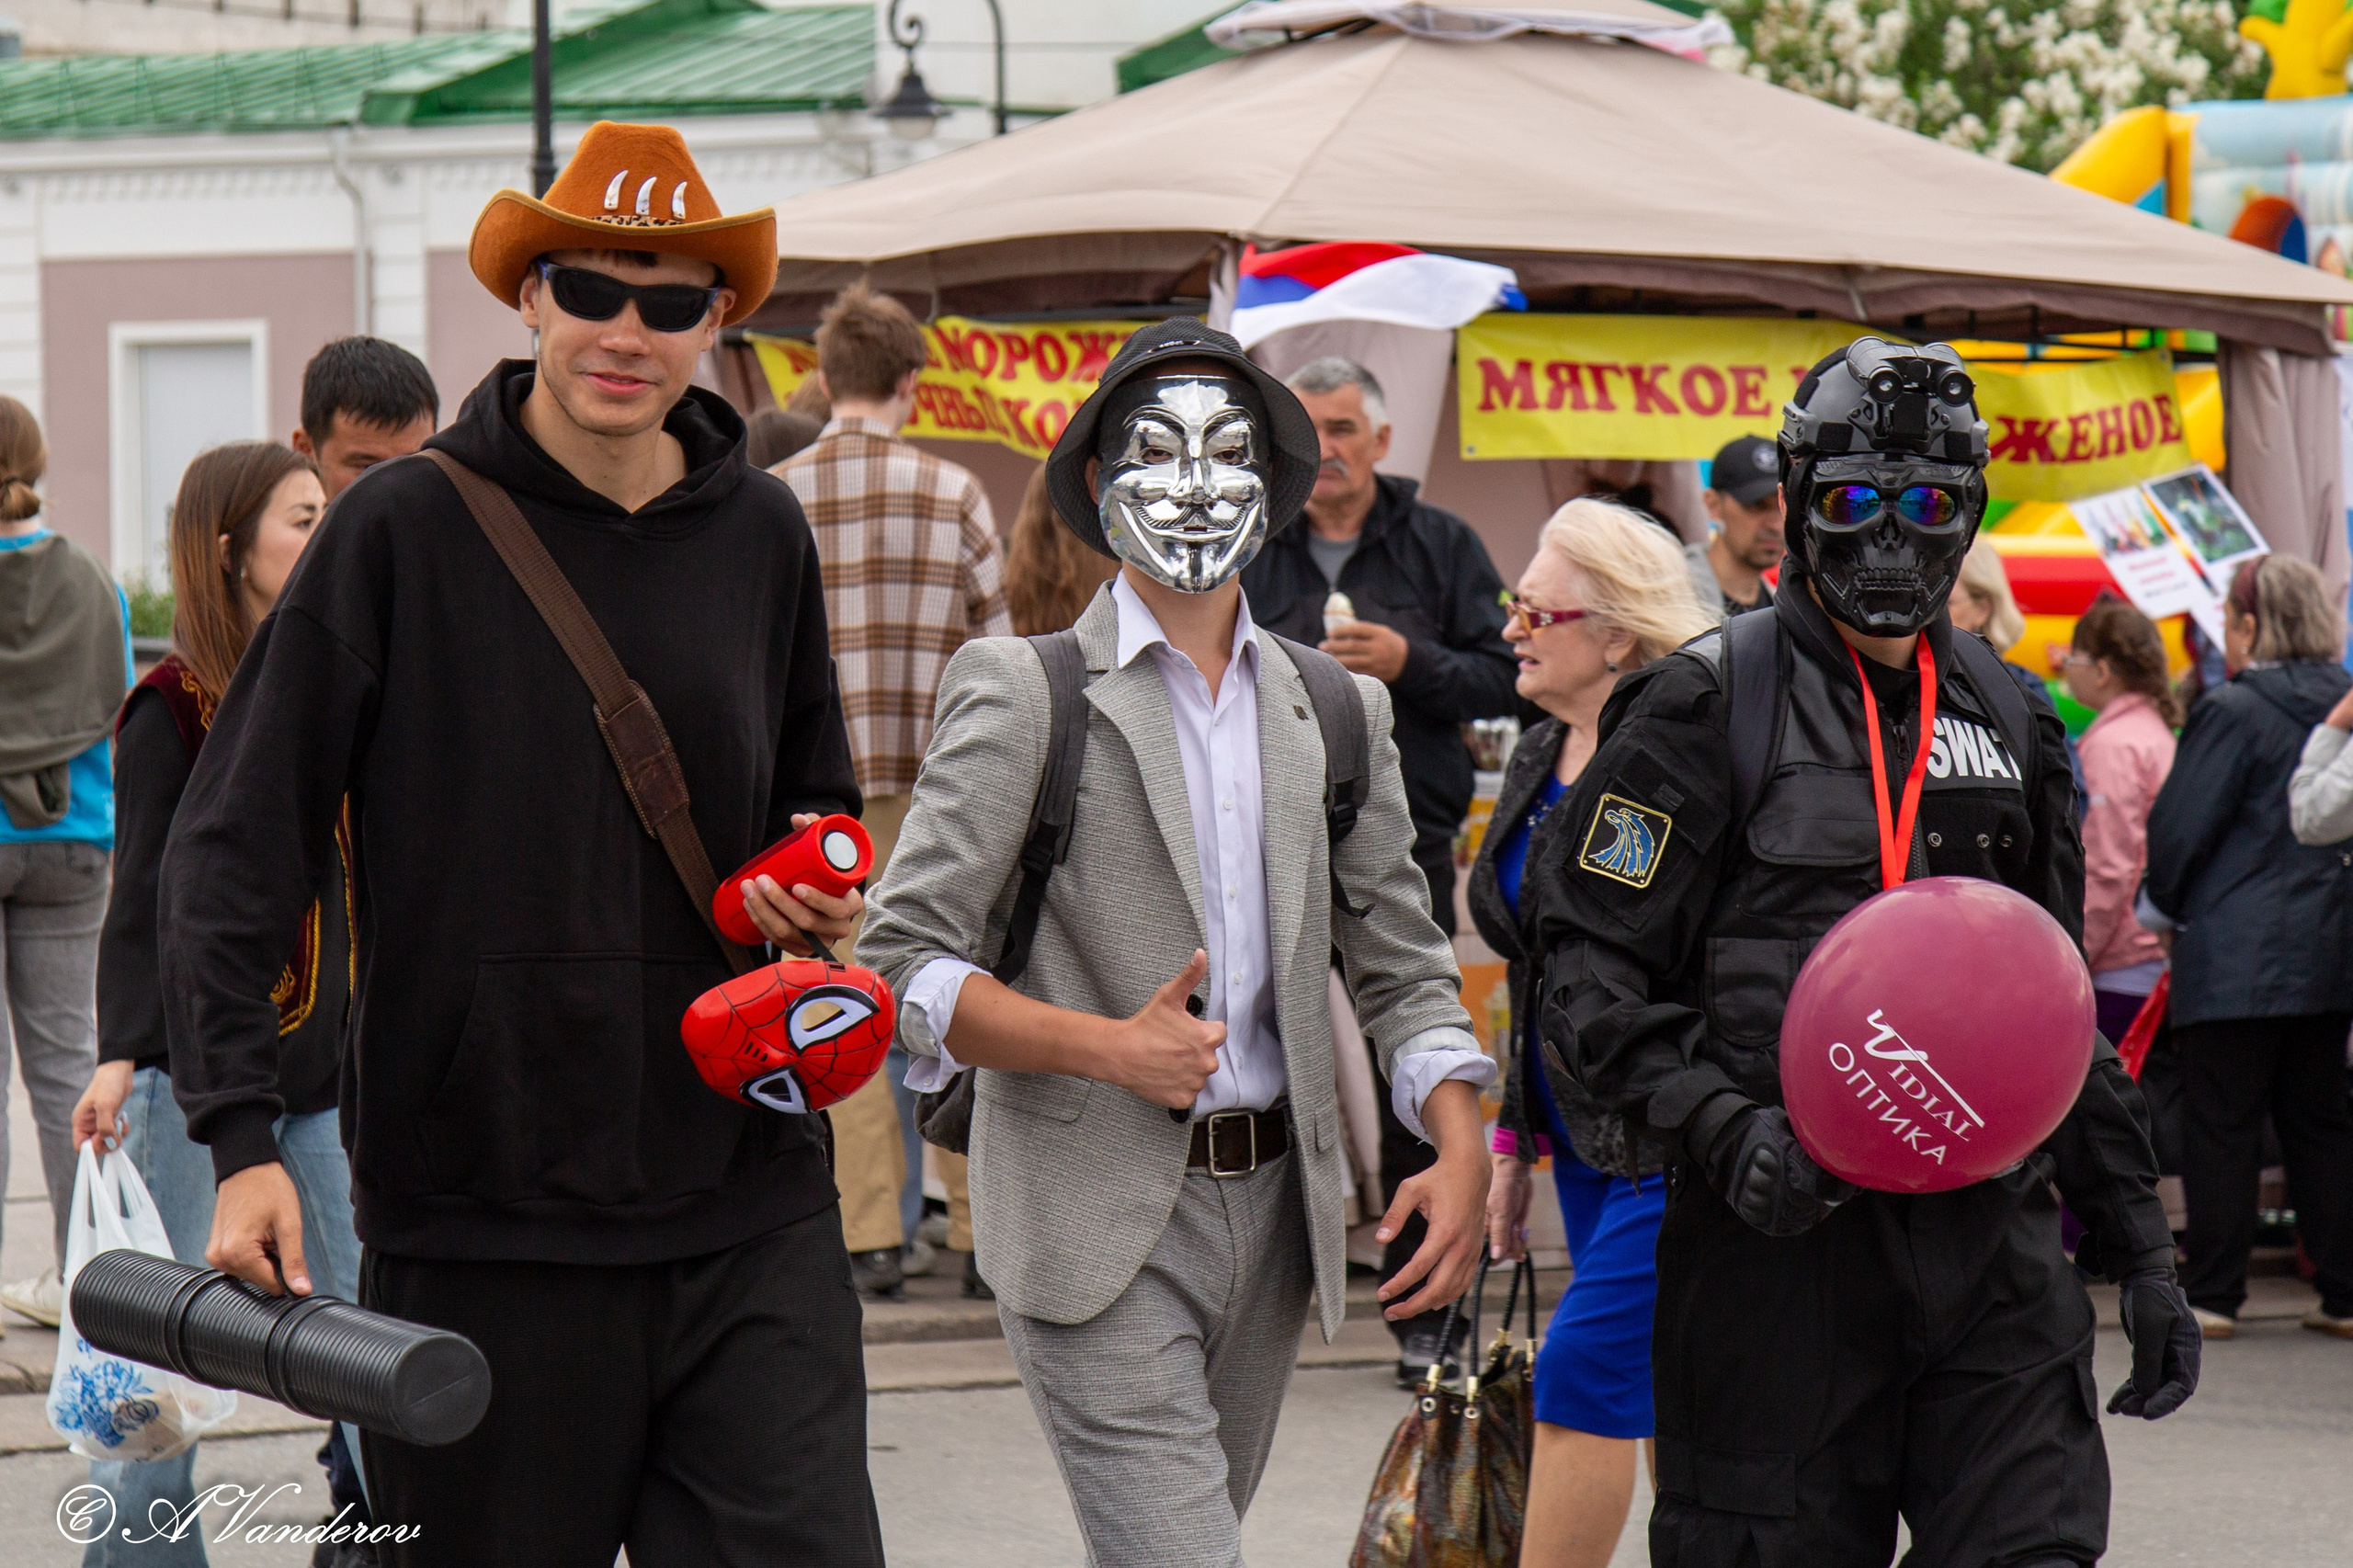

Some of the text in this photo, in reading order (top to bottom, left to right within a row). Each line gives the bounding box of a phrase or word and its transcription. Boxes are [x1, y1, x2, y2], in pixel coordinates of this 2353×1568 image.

[932, 326, 1133, 382] МОРОЖ
[1475, 357, 1772, 417] МЯГКОЕ
[1001, 397, 1085, 450] КО
[1989, 392, 2183, 465] ЖЕНОЕ
[1828, 1042, 1947, 1165] ОПТИКА
